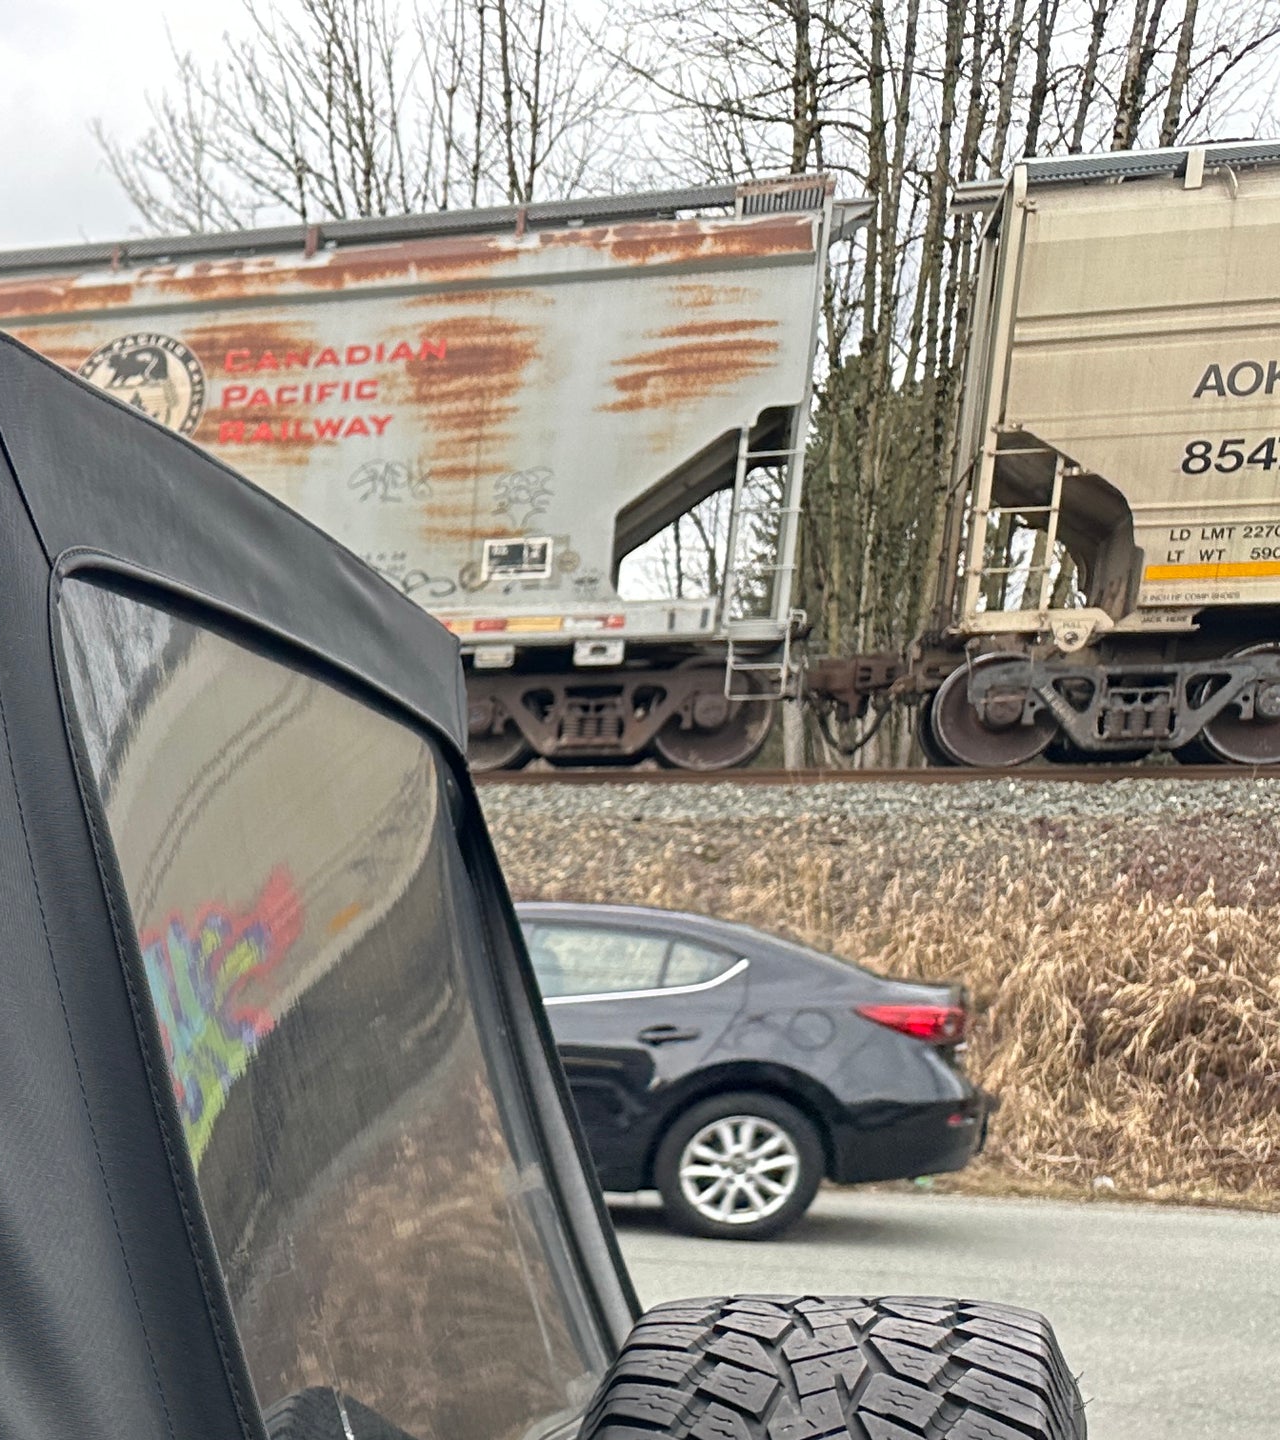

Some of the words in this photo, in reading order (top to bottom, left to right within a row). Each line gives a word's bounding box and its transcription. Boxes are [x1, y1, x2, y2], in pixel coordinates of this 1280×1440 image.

[224, 338, 447, 373] CANADIAN
[222, 379, 379, 408] PACIFIC
[218, 414, 393, 444] RAILWAY
[1181, 437, 1280, 475] 854
[1169, 528, 1191, 542] LD
[1200, 526, 1237, 541] LMT
[1166, 549, 1185, 563] LT
[1199, 548, 1226, 562] WT
